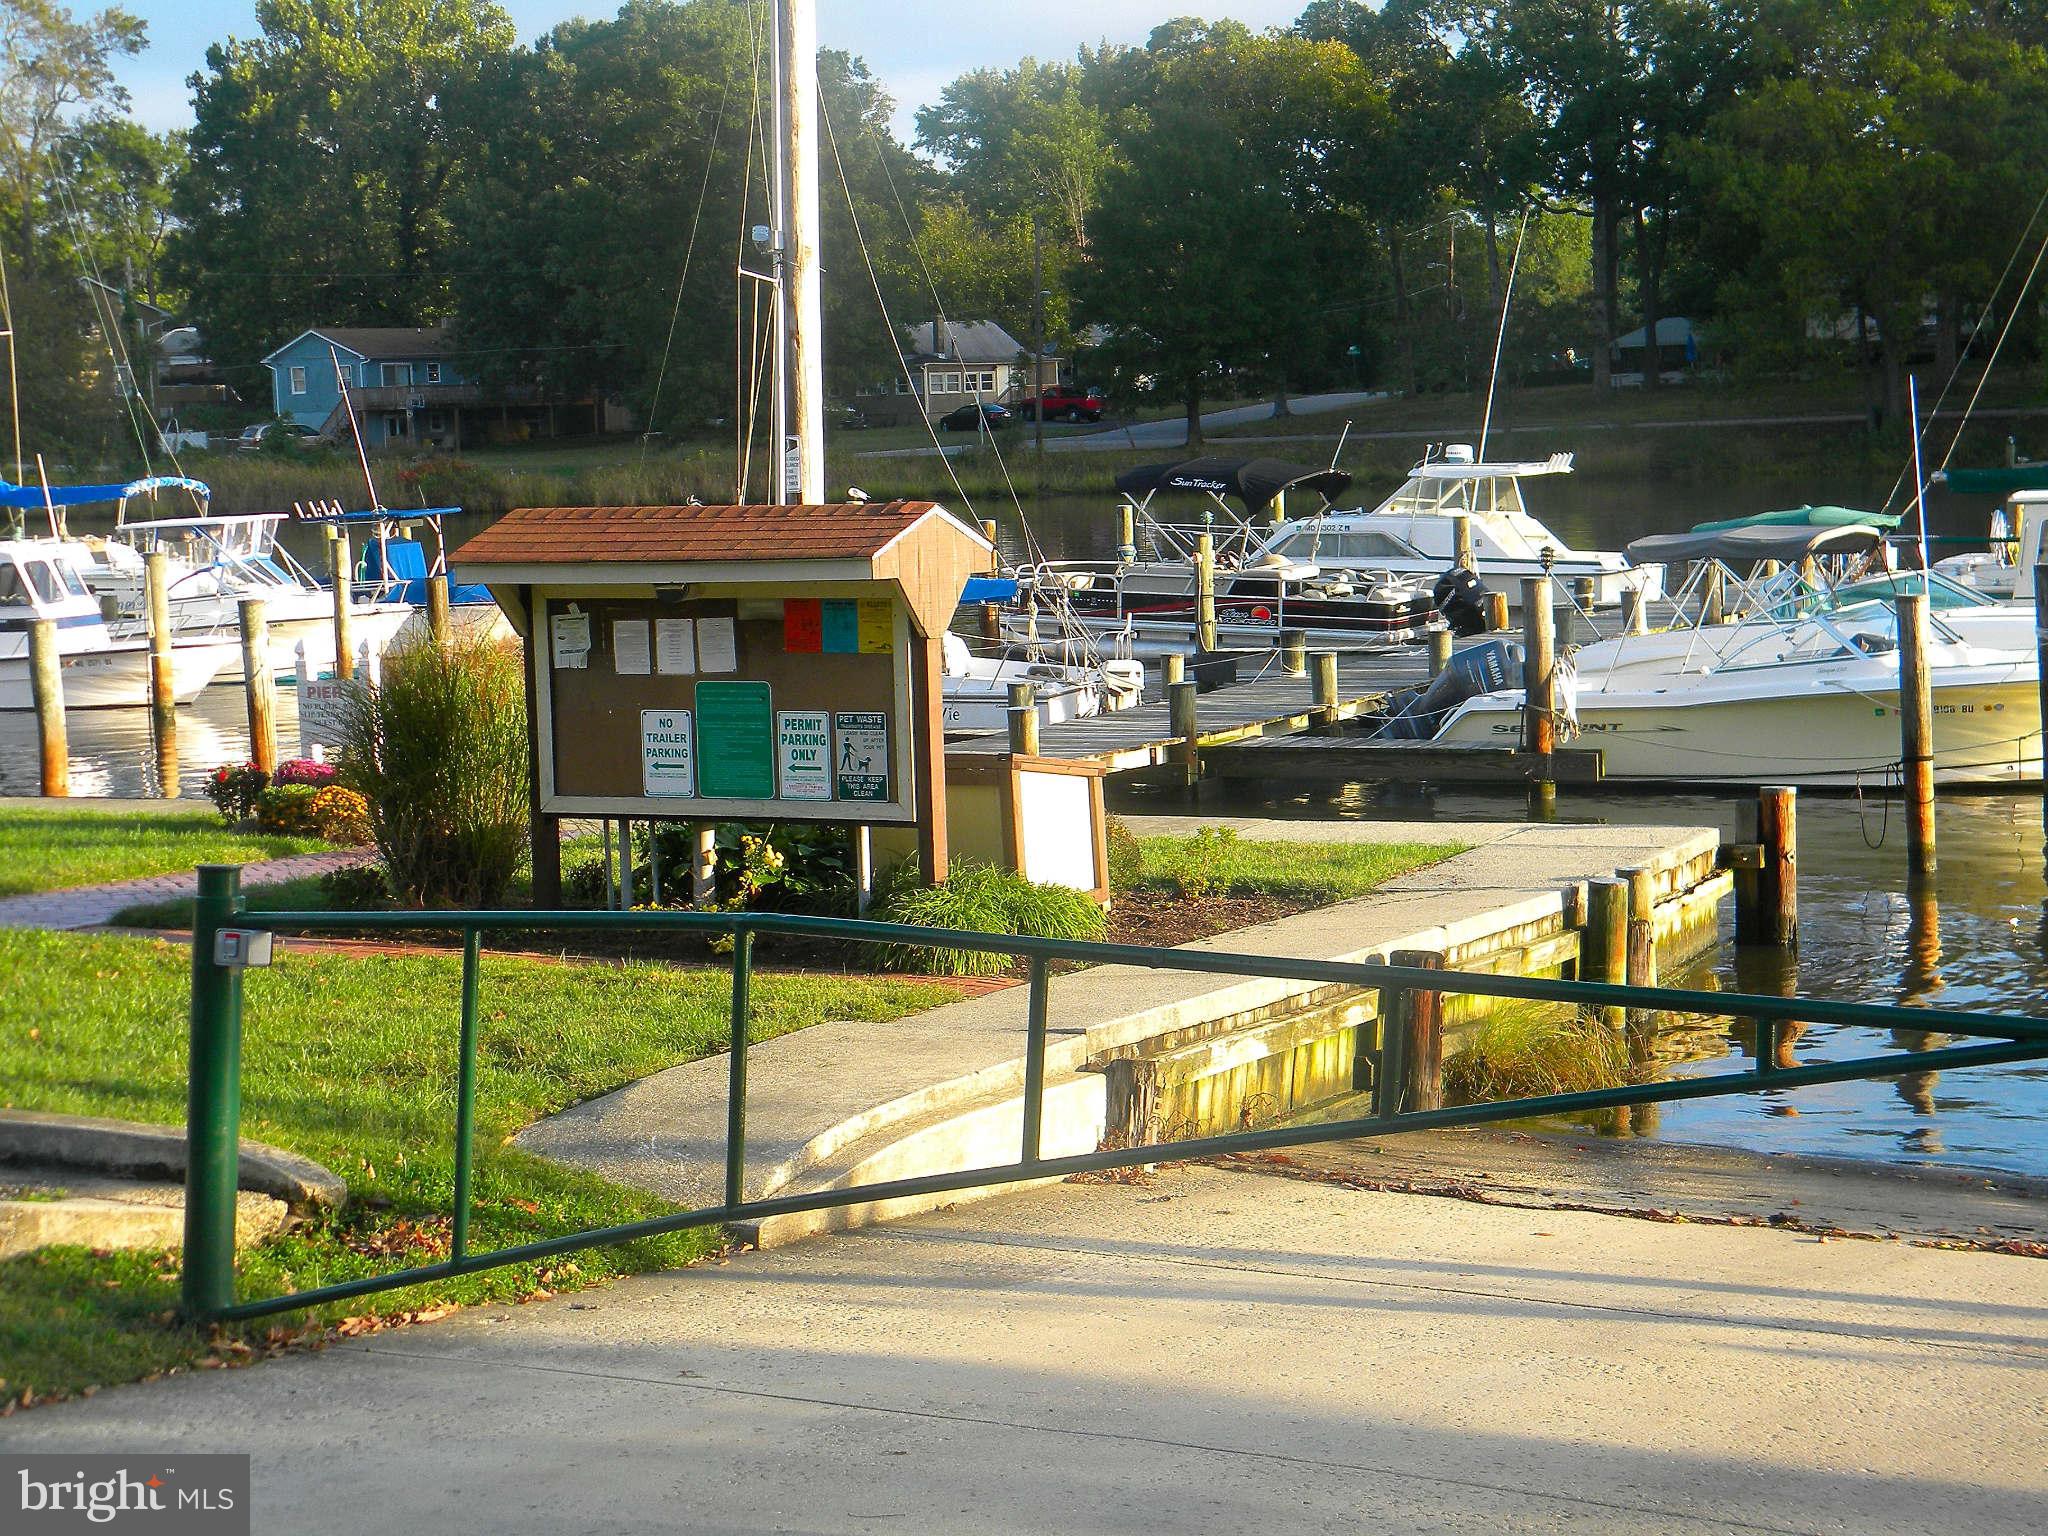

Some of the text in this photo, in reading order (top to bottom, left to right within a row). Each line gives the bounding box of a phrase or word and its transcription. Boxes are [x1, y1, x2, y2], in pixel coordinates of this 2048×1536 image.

[1487, 650, 1504, 686] YAMAHA
[659, 718, 673, 729] NO
[784, 718, 822, 731] PERMIT
[839, 715, 882, 724] PET WASTE
[646, 733, 687, 743] TRAILER
[781, 733, 827, 746] PARKING
[646, 748, 689, 758] PARKING
[791, 748, 817, 761] ONLY
